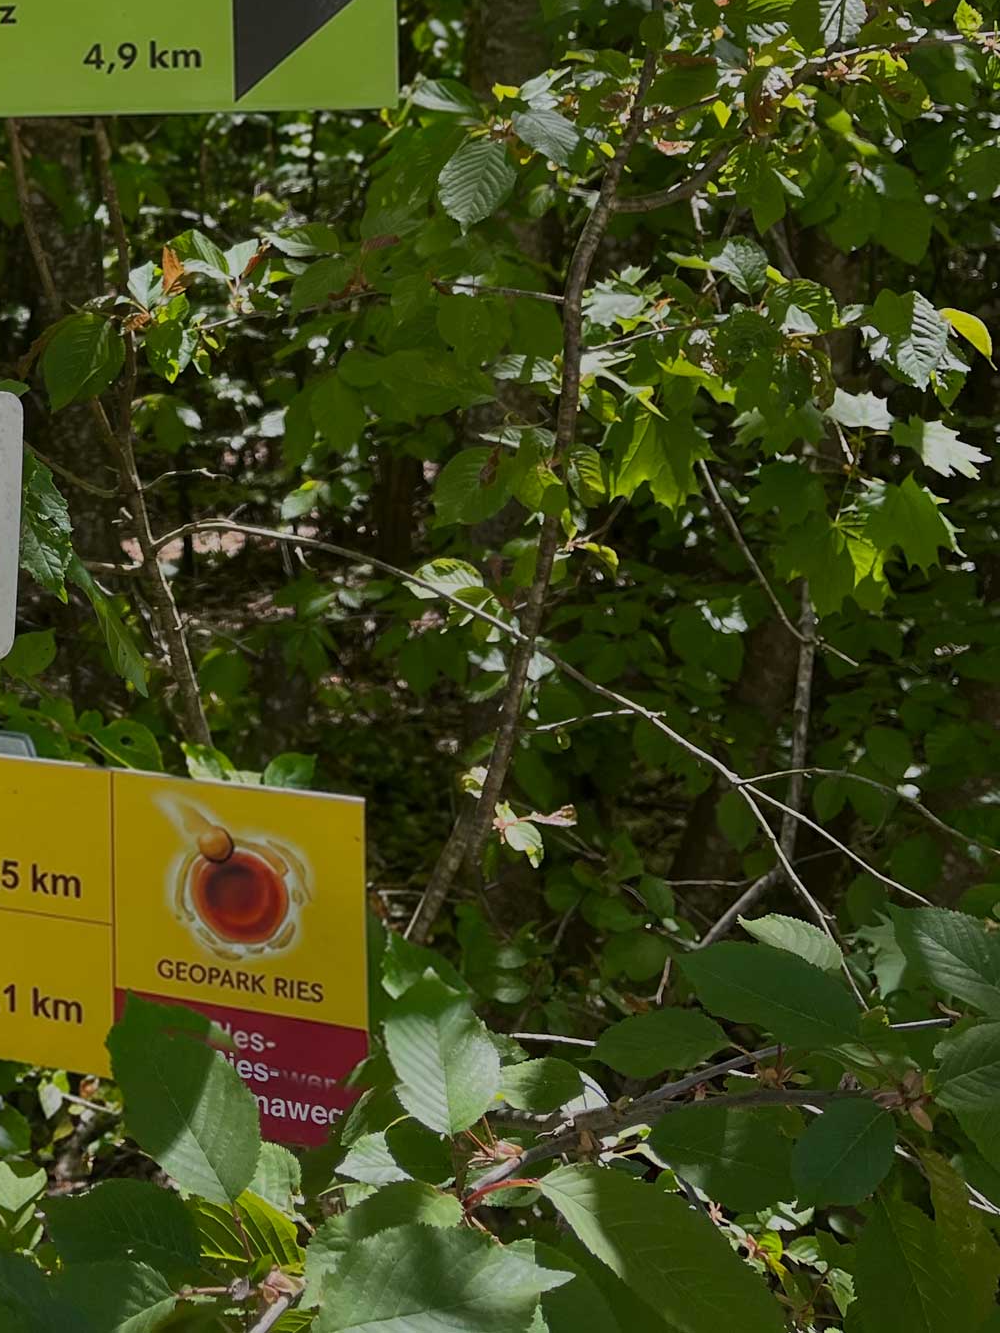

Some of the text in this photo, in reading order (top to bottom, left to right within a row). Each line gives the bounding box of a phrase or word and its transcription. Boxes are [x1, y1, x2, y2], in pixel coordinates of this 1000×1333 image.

[82, 40, 202, 75] 4,9 km
[31, 863, 81, 899] km
[157, 958, 324, 1004] GEOPARK RIES
[32, 987, 83, 1025] km
